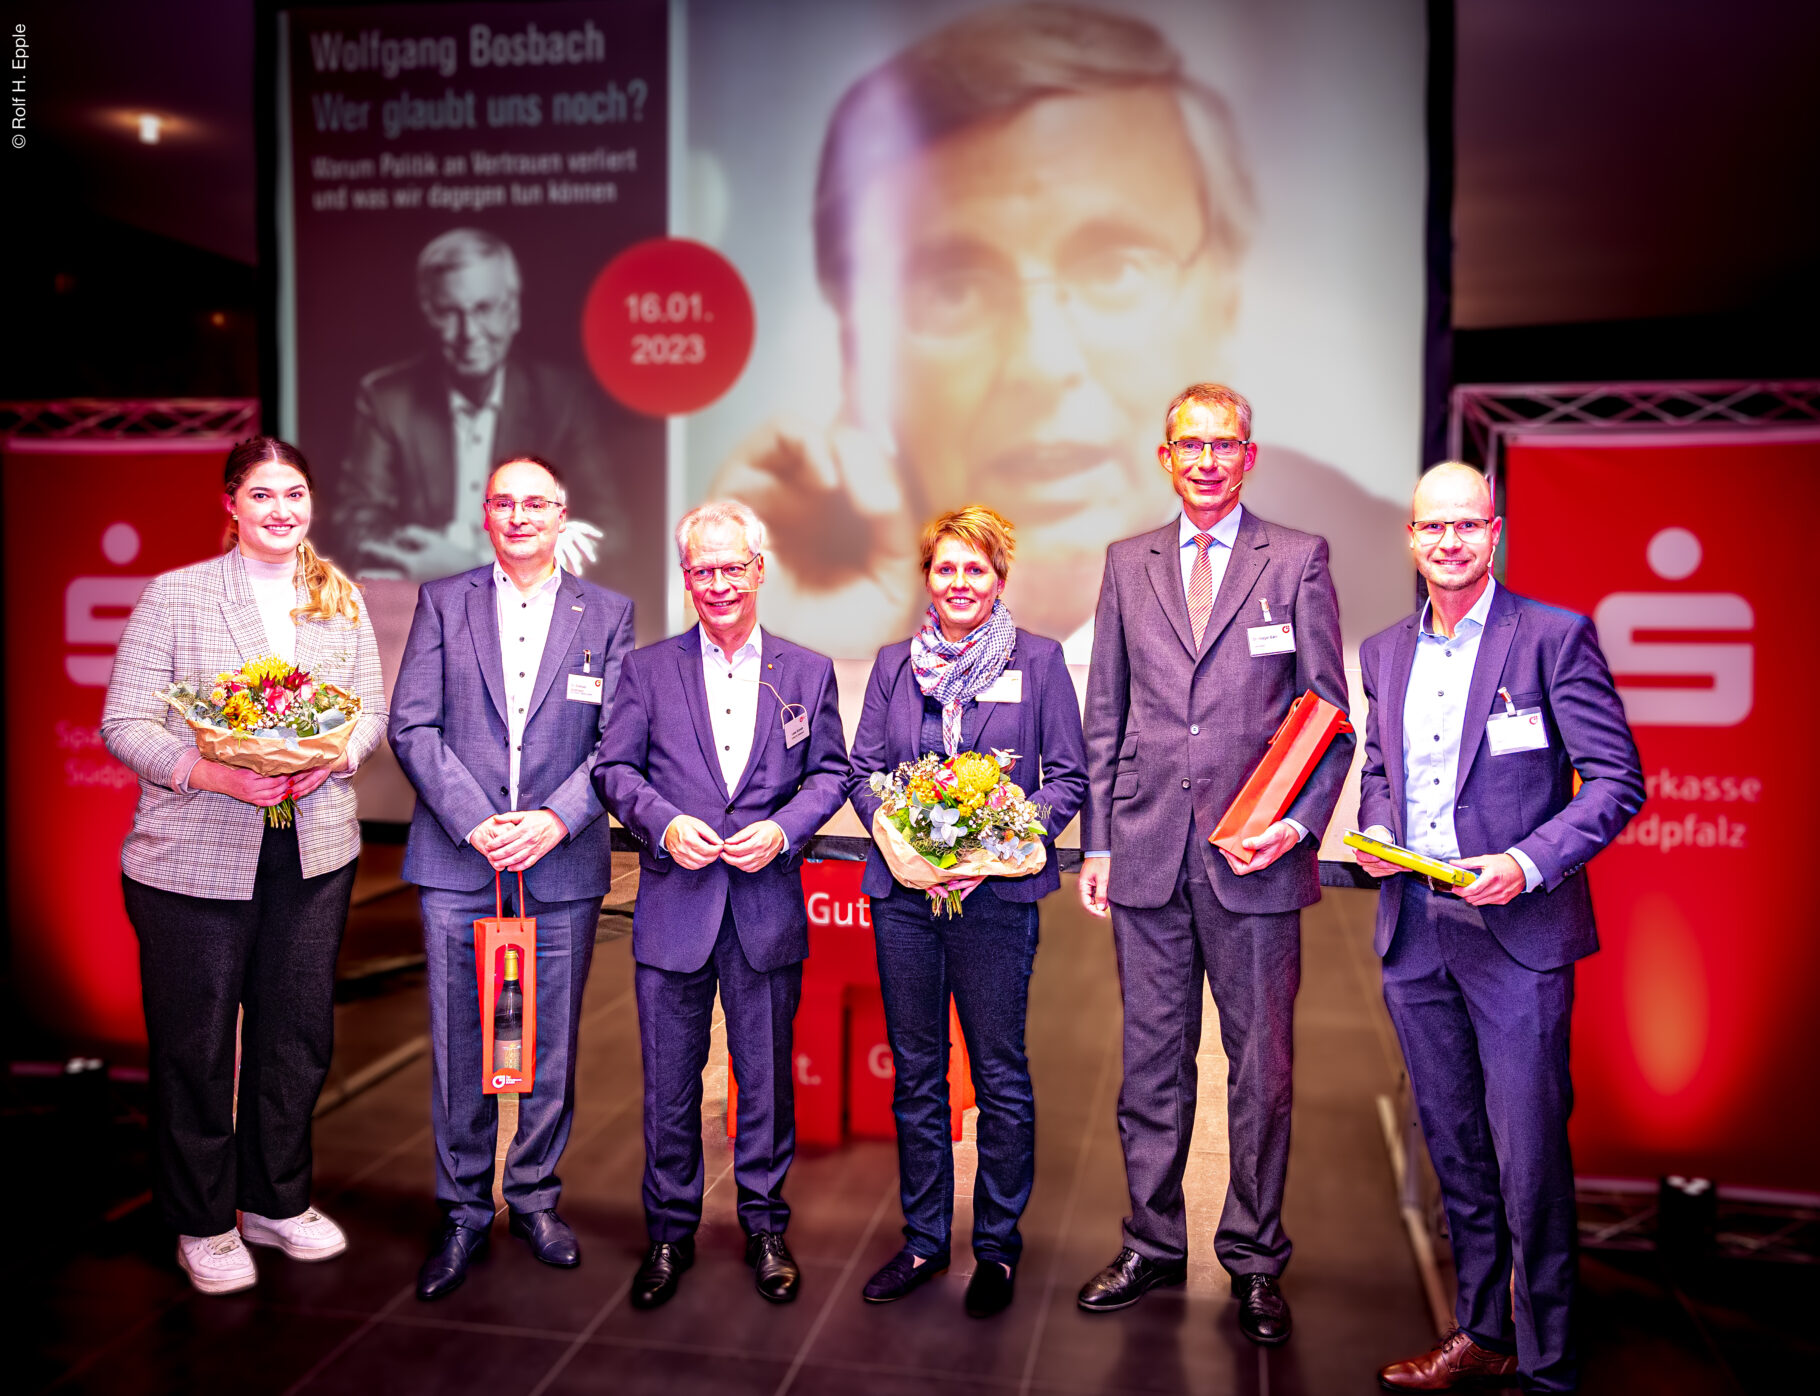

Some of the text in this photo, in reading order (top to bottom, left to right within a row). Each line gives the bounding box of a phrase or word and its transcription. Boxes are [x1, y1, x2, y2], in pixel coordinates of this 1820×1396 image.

[310, 19, 606, 79] Wolfgang Bosbach
[312, 77, 648, 140] Wer glaubt uns noch?
[311, 147, 637, 180] Warum Politik an Vertrauen verliert
[312, 179, 618, 213] und was wir dagegen tun können
[624, 291, 715, 323] 16.01.
[631, 333, 706, 365] 2023
[807, 892, 870, 928] Gut
